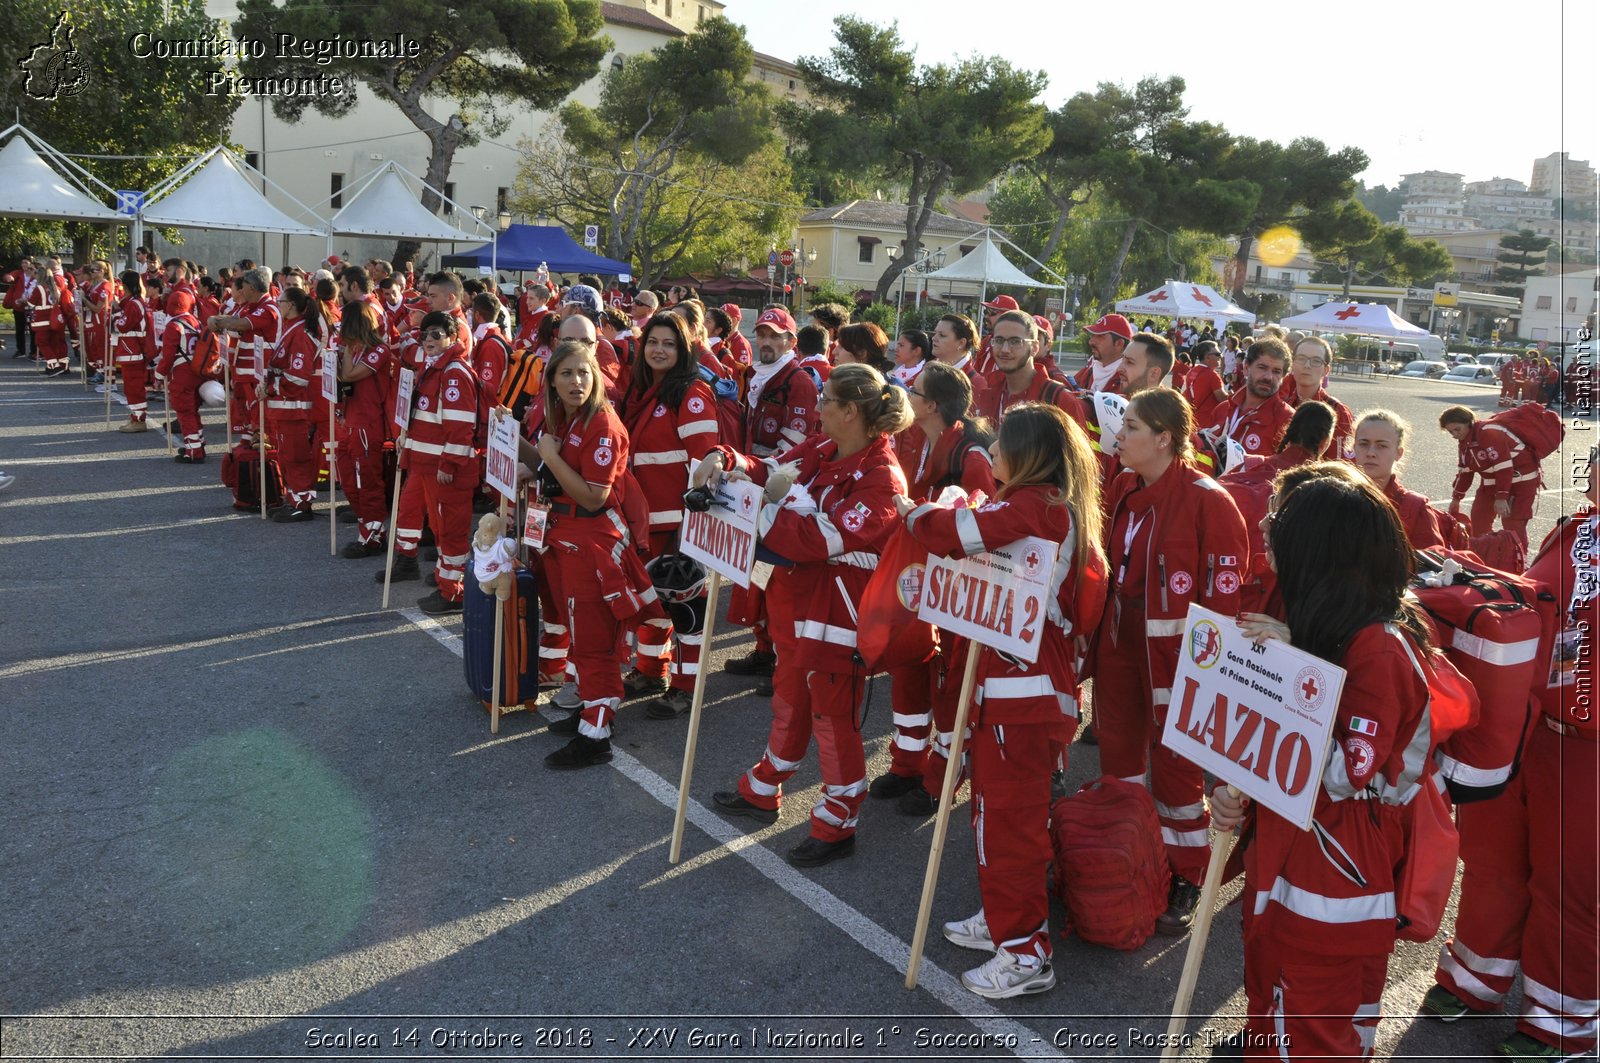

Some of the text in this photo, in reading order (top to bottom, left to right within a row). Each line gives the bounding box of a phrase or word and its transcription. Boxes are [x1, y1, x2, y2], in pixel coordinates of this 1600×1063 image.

[123, 193, 137, 212] P
[686, 512, 751, 573] PIEMONTE
[927, 565, 1039, 644] SICILIA 2
[1227, 650, 1283, 684] Gara Nazionale
[1250, 641, 1267, 656] XXV
[1219, 666, 1283, 703] di Primo Soccorso
[1175, 675, 1312, 796] LAZIO
